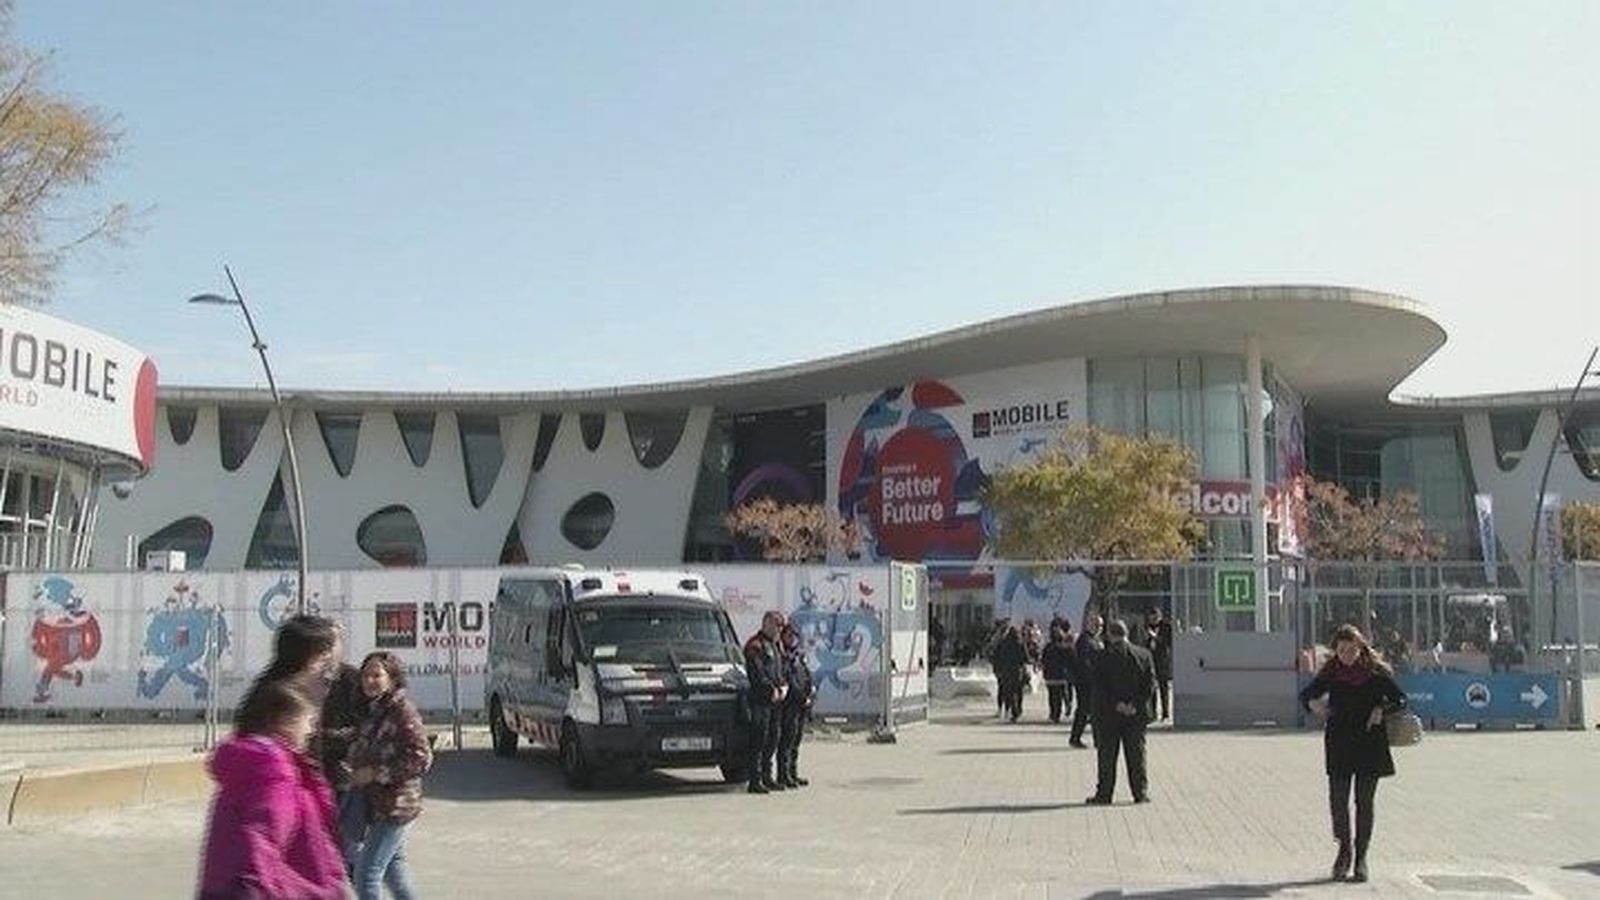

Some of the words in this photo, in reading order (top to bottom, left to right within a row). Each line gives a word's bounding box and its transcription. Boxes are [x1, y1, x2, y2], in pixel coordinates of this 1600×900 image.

[0, 328, 117, 402] OBILE
[993, 401, 1068, 426] MOBILE
[882, 477, 941, 499] Better
[882, 502, 944, 525] Future
[423, 602, 494, 631] MO
